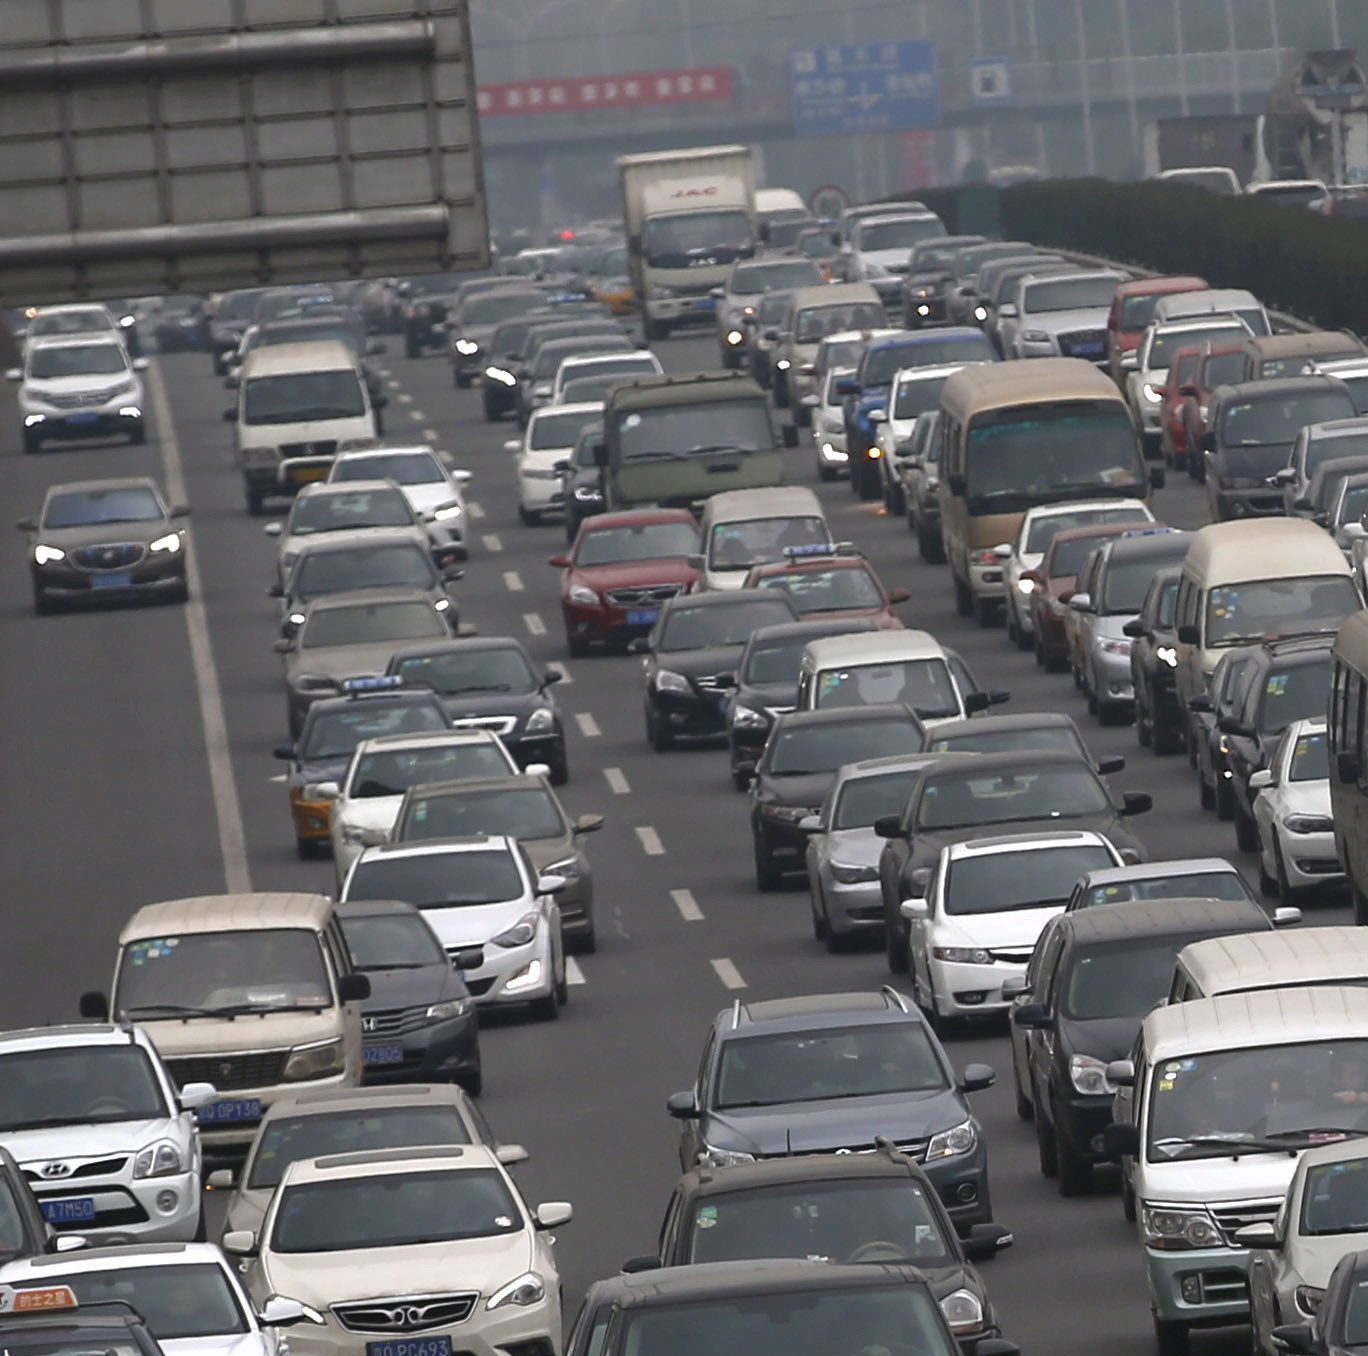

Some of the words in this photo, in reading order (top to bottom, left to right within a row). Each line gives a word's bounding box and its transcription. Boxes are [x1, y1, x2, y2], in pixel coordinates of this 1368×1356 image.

[50, 1200, 95, 1220] A7M50
[20, 1290, 72, 1308] 的士之星
